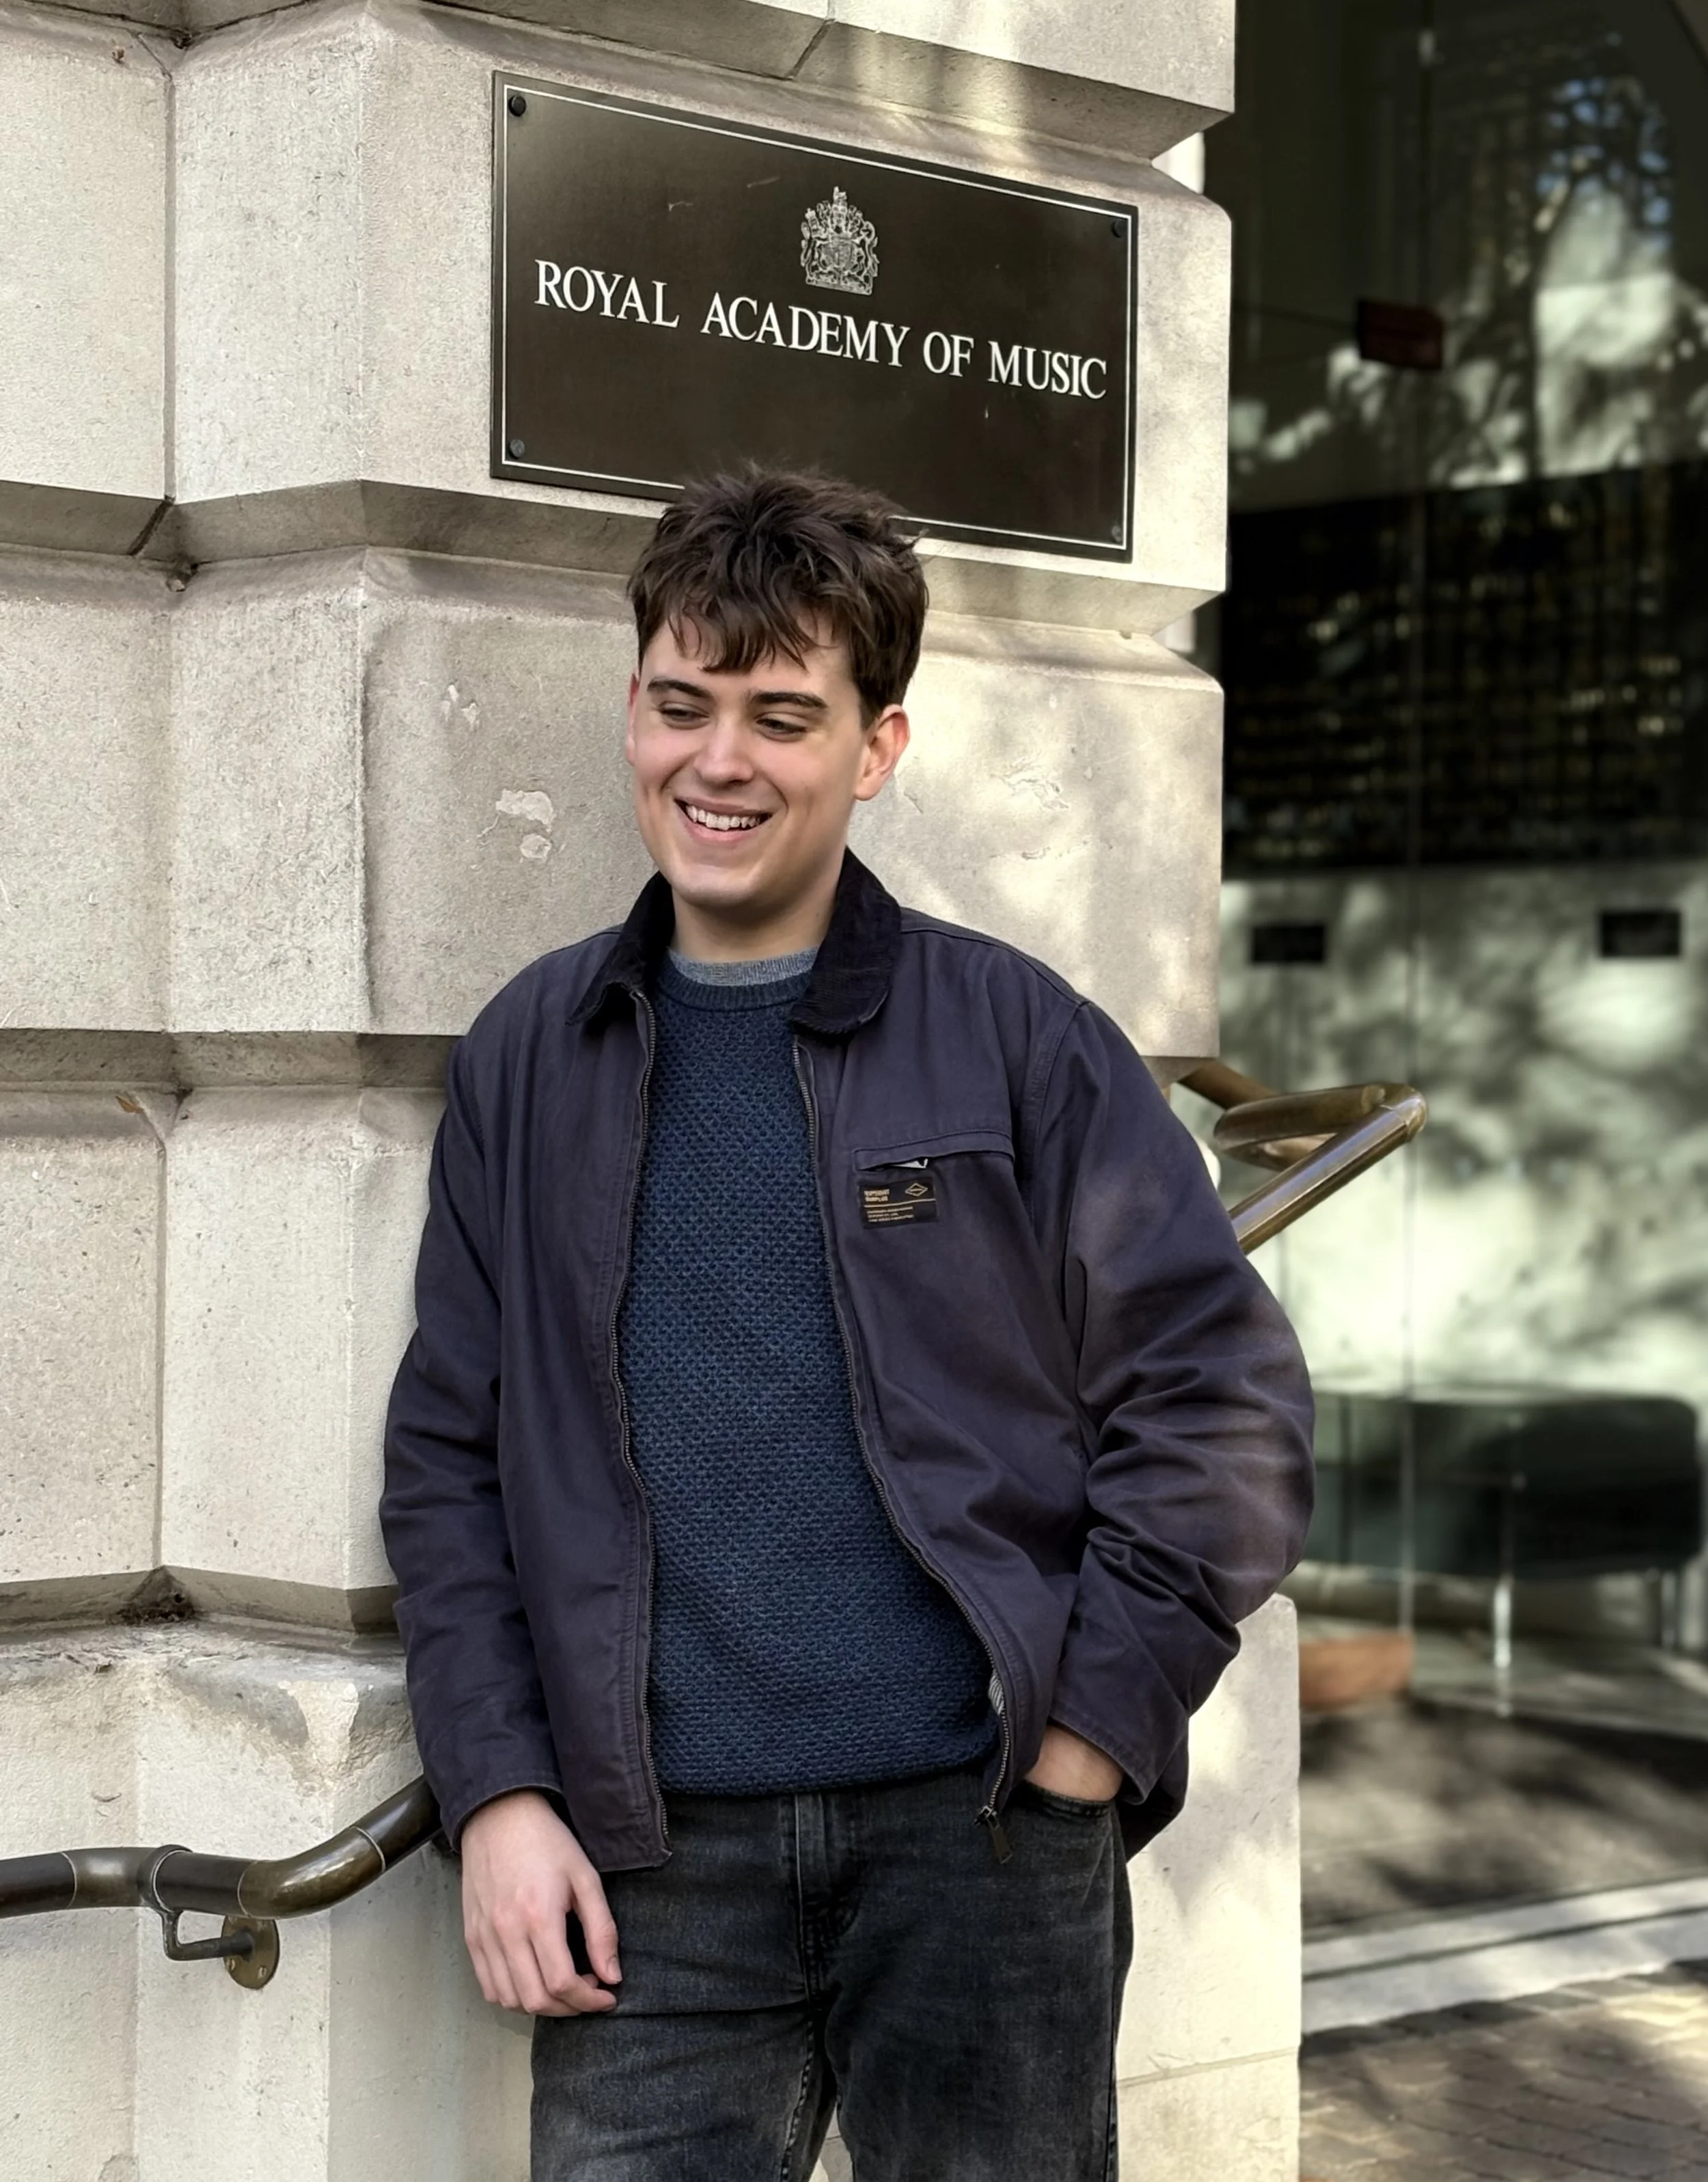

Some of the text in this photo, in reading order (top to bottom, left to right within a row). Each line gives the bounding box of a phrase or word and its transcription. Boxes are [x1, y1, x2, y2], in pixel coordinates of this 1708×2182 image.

[534, 259, 1107, 399] ROYAL ACADEMY OF MUSIC
